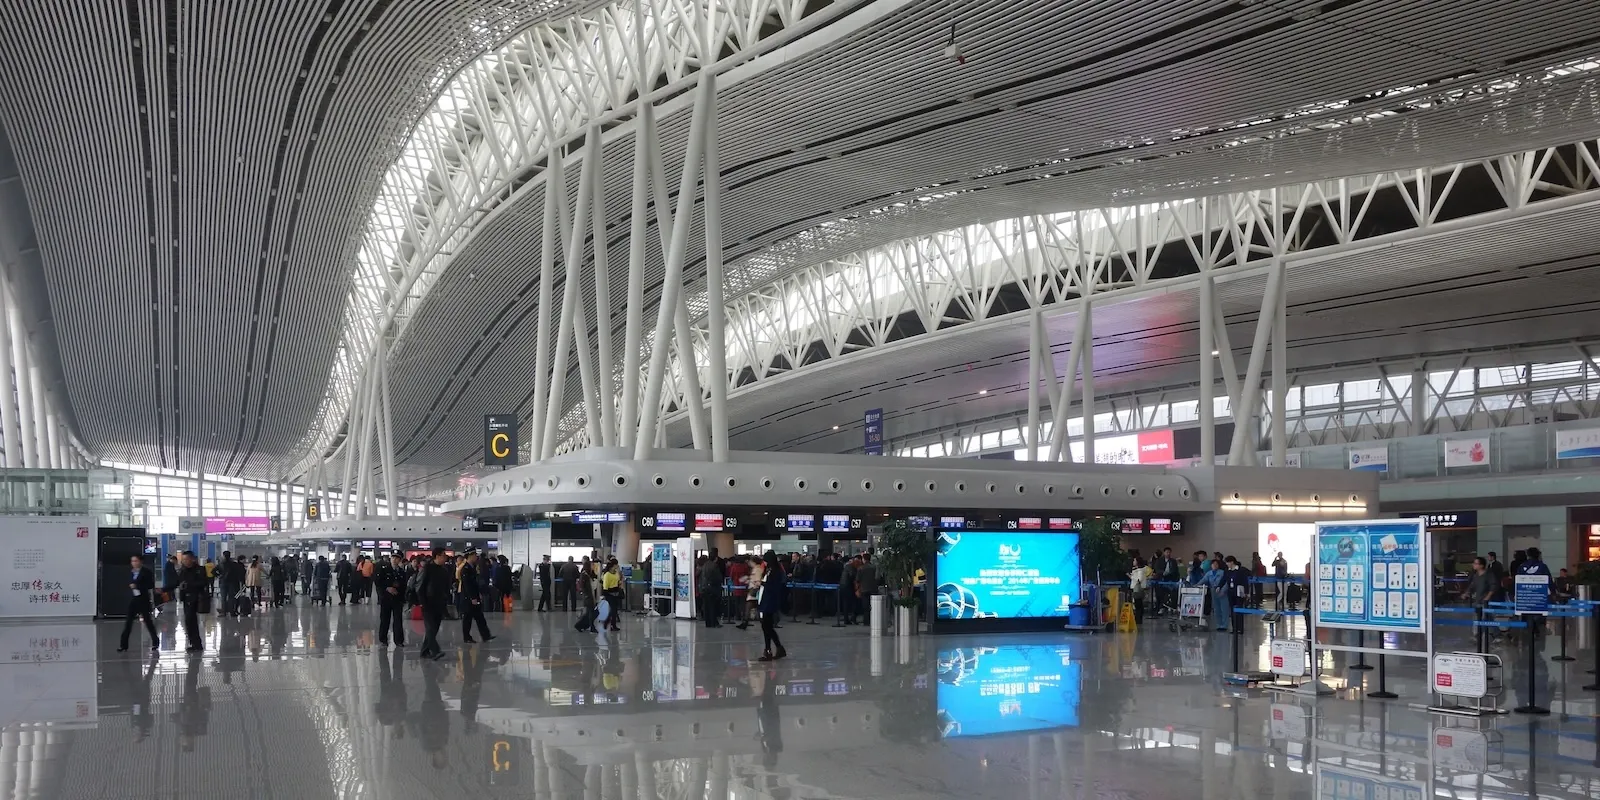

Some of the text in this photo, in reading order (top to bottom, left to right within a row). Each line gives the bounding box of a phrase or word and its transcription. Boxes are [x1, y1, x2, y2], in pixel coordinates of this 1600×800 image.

[491, 433, 510, 458] C
[309, 506, 318, 517] B
[273, 521, 279, 529] A
[642, 516, 654, 527] C60
[725, 517, 738, 528] C59
[774, 517, 786, 528] C58
[851, 518, 862, 528] C57
[1007, 520, 1017, 529] C54
[1172, 521, 1181, 531] C51
[11, 578, 63, 591] 忠厚传家久
[29, 591, 81, 603] 诗书继世长
